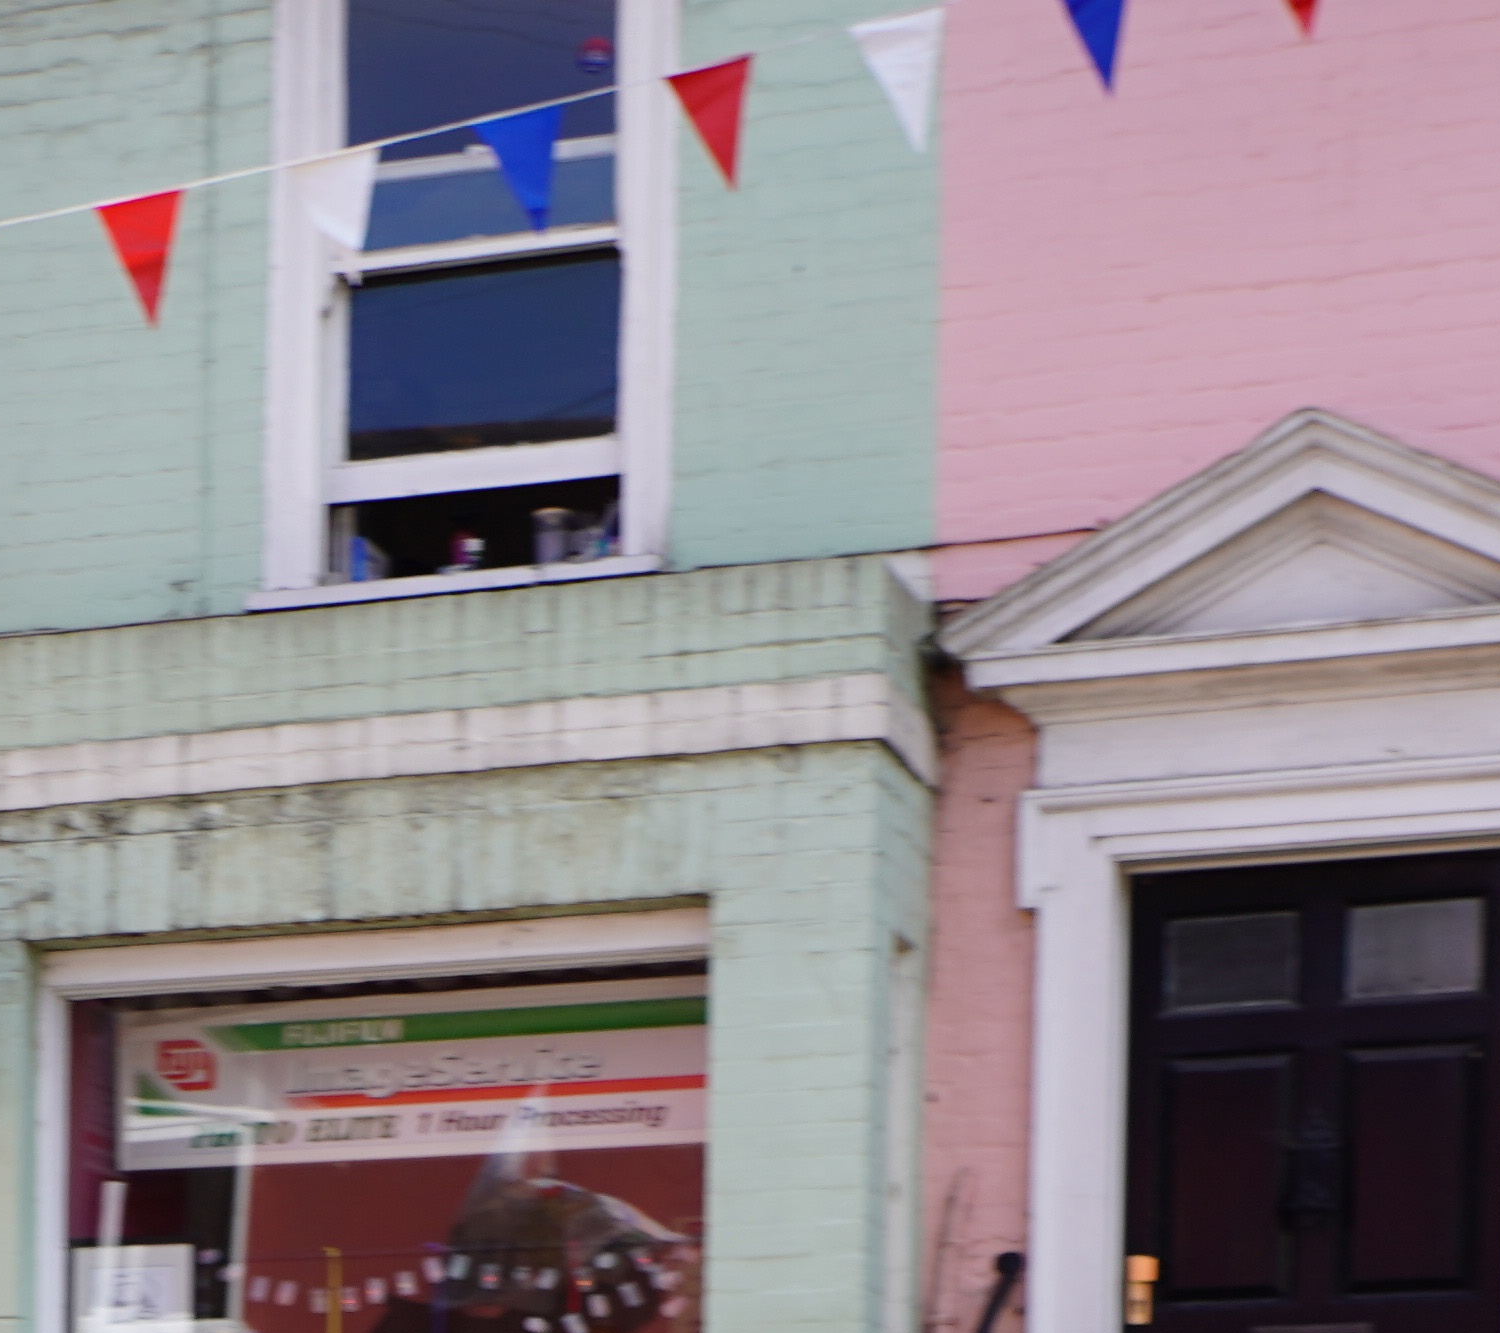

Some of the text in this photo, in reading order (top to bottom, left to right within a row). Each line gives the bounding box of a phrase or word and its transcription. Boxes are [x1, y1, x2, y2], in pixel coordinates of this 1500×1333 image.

[283, 1018, 404, 1047] FUJIFILM
[437, 1112, 507, 1132] Hour
[518, 1101, 668, 1128] Processing
